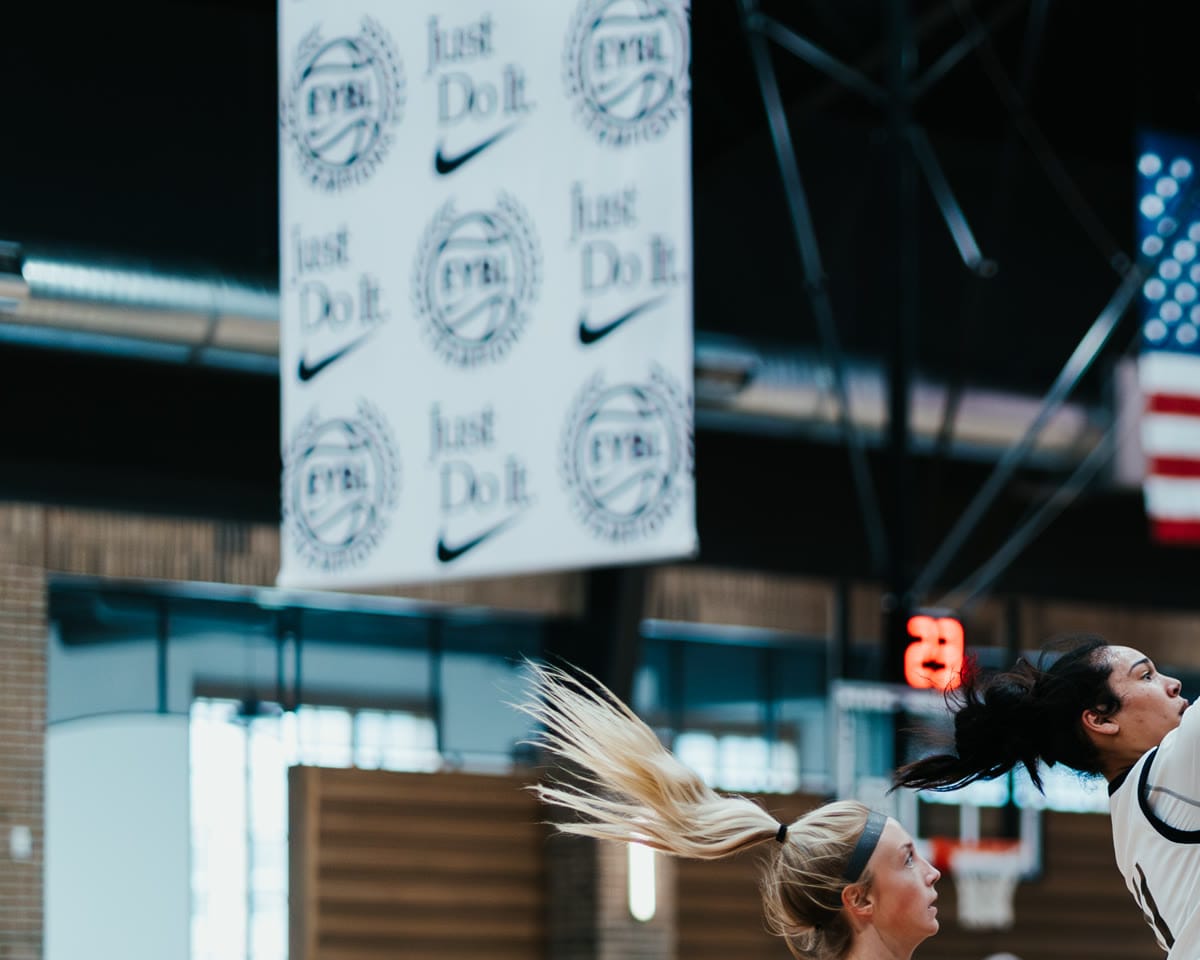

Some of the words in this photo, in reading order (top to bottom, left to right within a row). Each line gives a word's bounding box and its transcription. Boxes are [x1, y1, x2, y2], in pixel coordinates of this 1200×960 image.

[424, 12, 496, 78] Just
[438, 71, 499, 128] Do
[567, 180, 639, 244] Just
[581, 239, 643, 299] Do
[299, 281, 354, 334] Do
[426, 401, 497, 467] Just
[440, 460, 502, 517] Do
